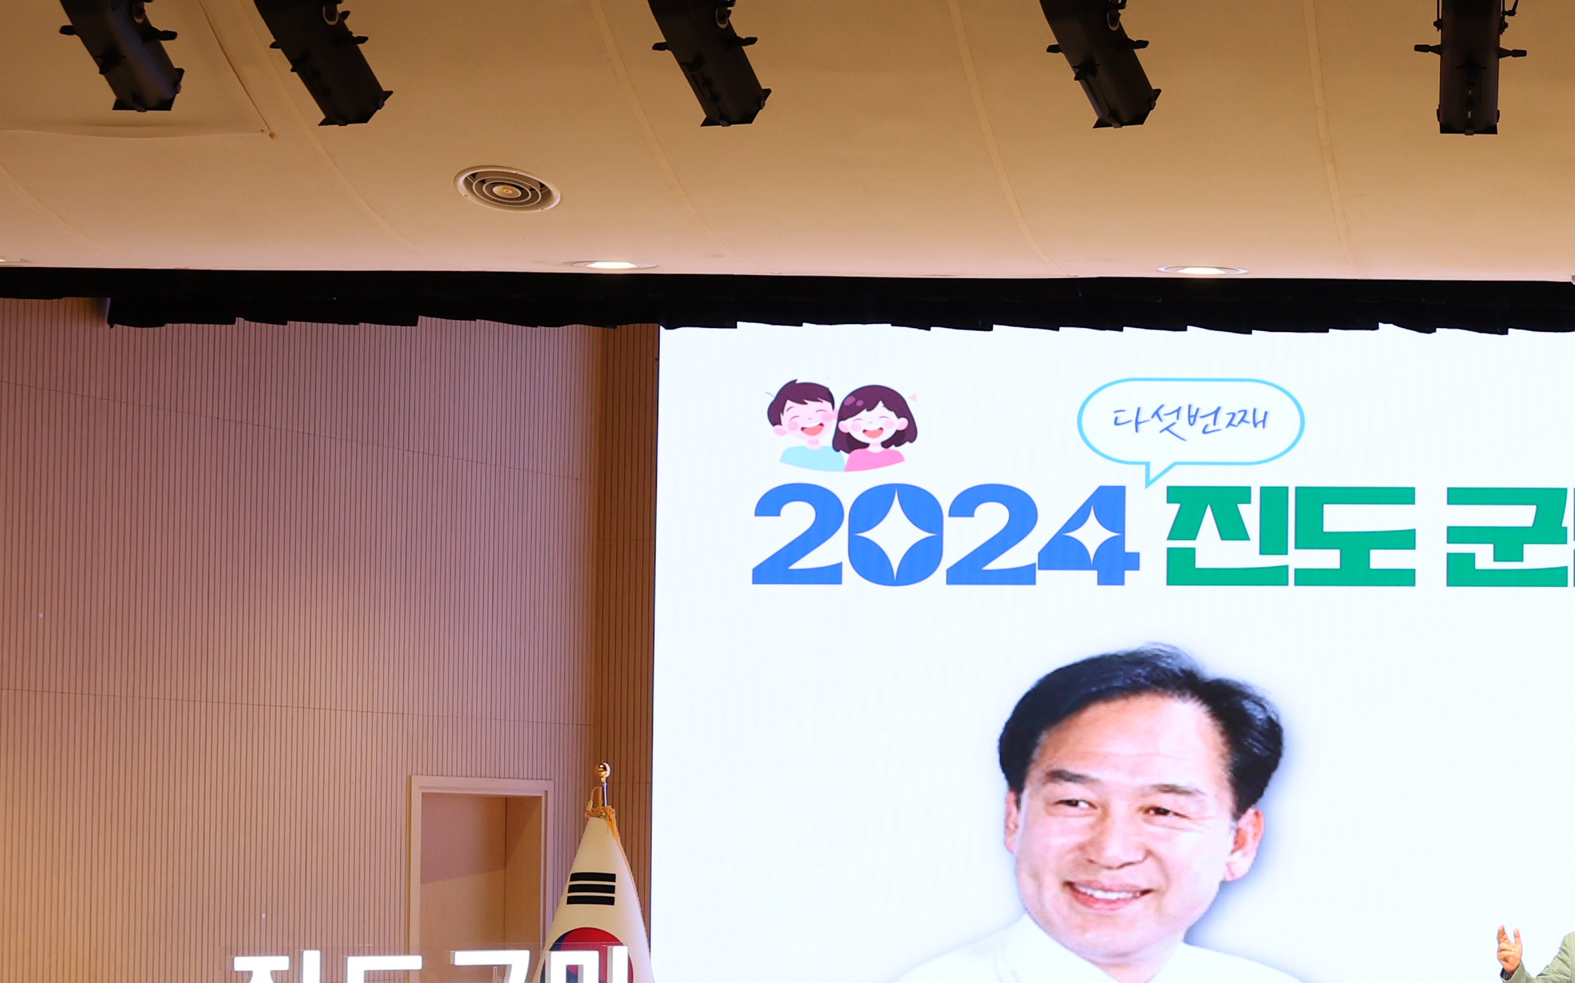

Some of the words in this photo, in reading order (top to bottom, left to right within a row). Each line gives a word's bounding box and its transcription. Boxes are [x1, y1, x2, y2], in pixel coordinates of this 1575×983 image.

[1113, 403, 1268, 442] 다섯번째
[752, 483, 1140, 586] 2024
[1166, 486, 1416, 587] 진도
